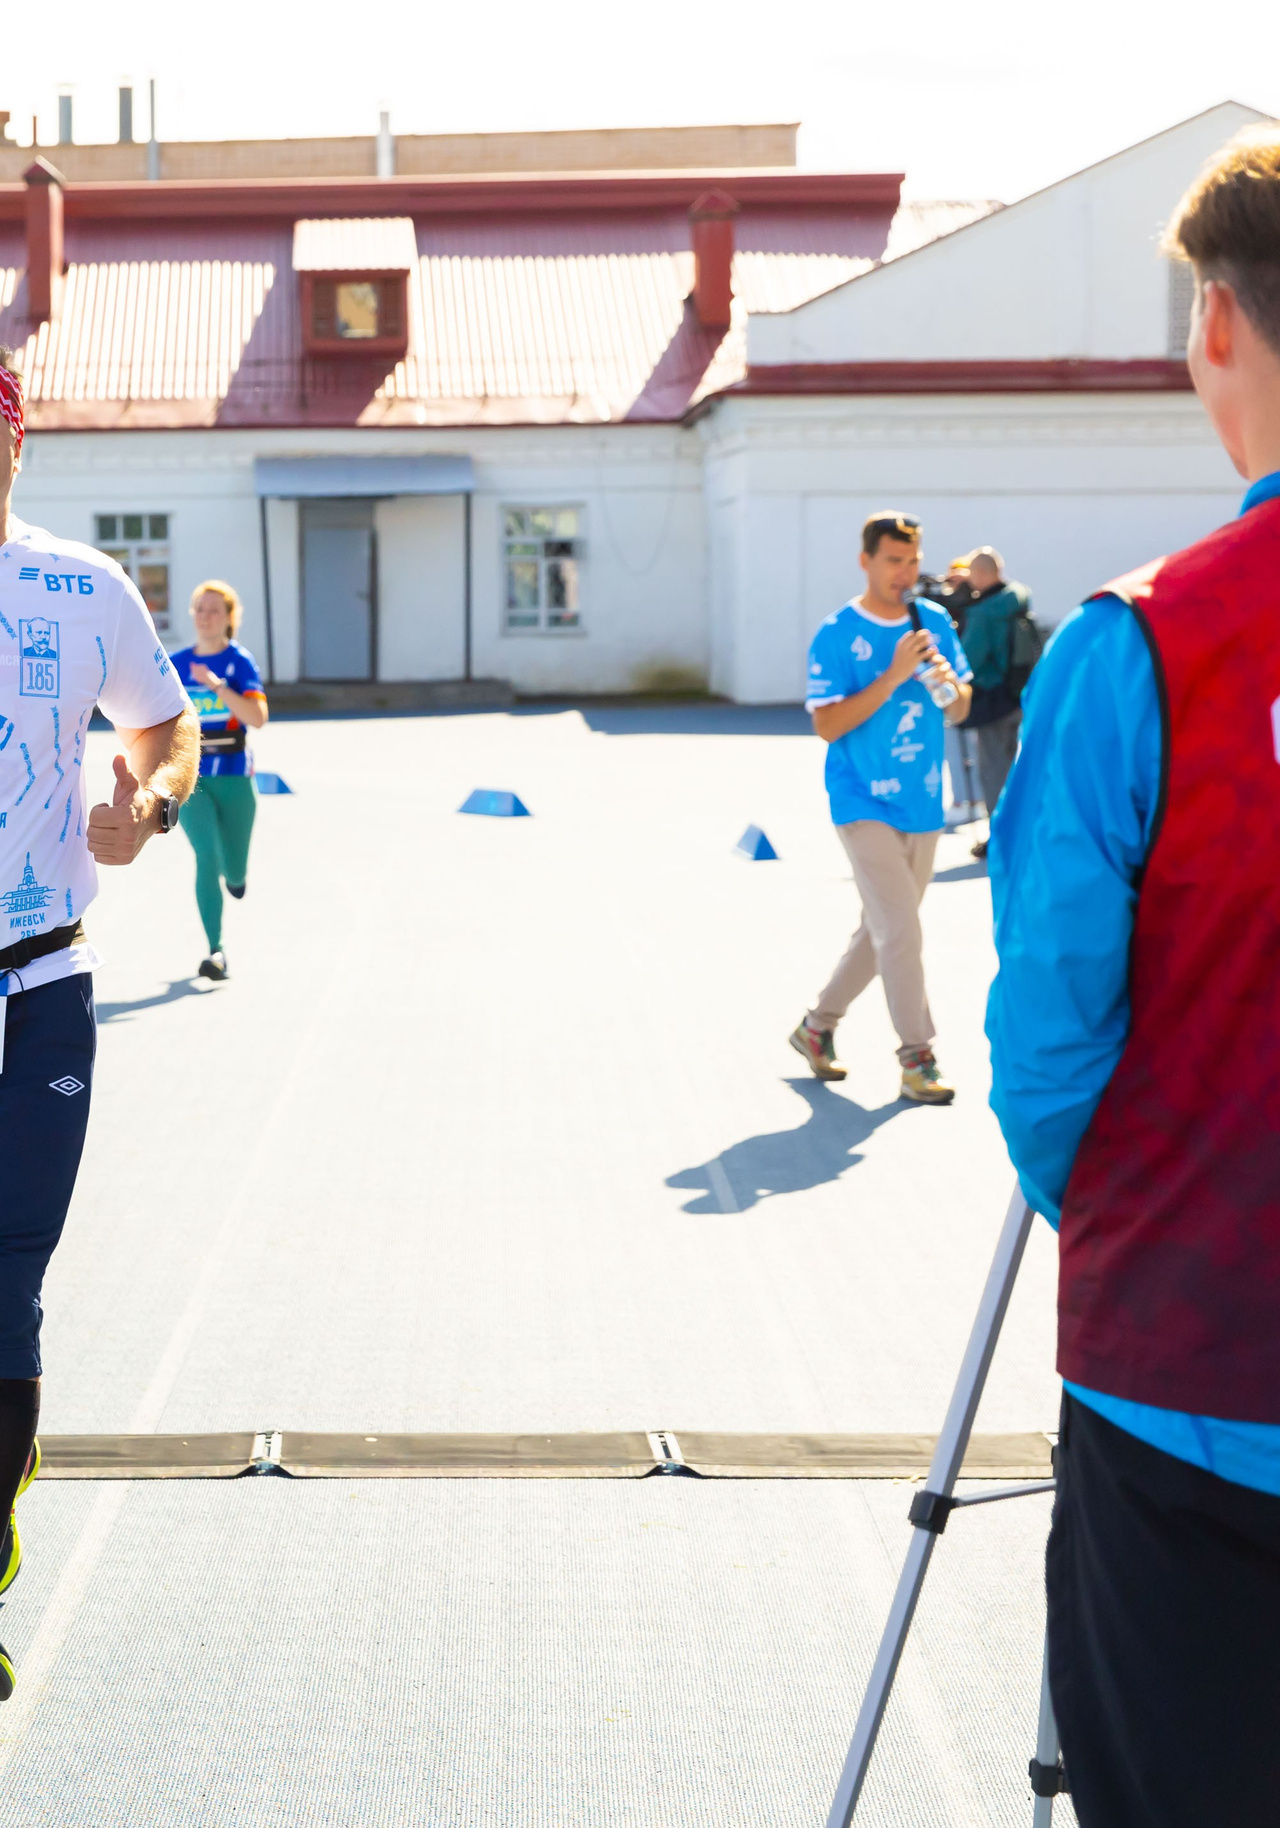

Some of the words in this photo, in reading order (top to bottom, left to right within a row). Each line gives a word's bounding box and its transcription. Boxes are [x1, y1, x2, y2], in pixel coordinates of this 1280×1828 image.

[44, 573, 94, 595] ВТБ
[27, 662, 55, 692] 185
[9, 912, 46, 929] ИЖЕВСК
